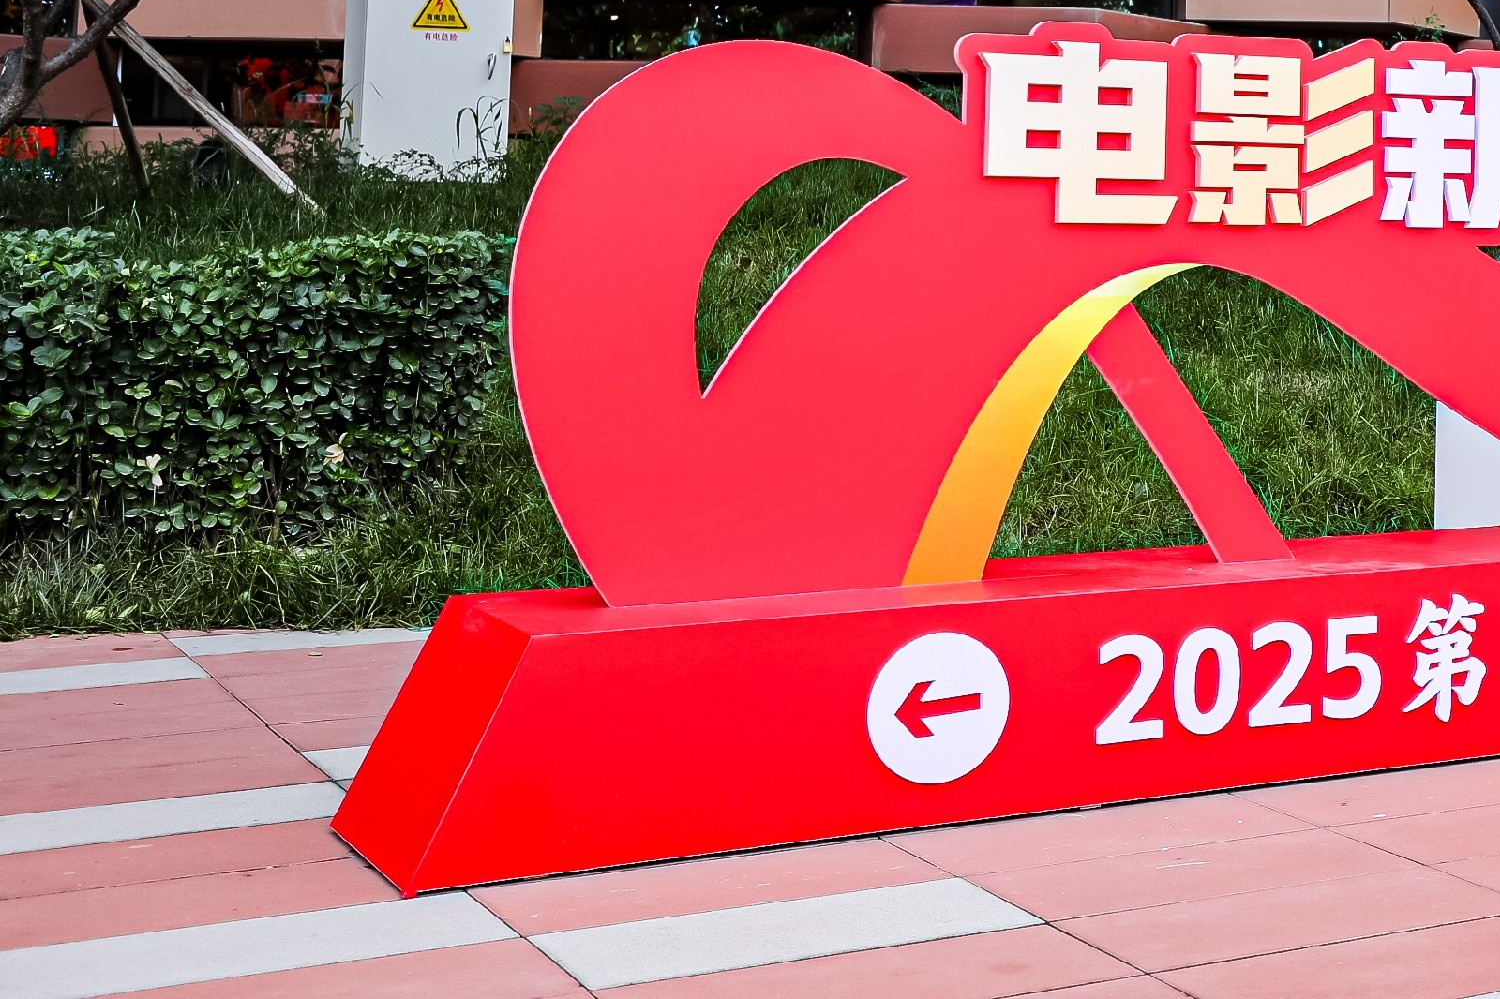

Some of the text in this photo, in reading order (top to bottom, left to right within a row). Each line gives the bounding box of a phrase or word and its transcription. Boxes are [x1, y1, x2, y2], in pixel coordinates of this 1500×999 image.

[427, 13, 456, 22] 有电危险
[424, 32, 458, 41] 有电危险
